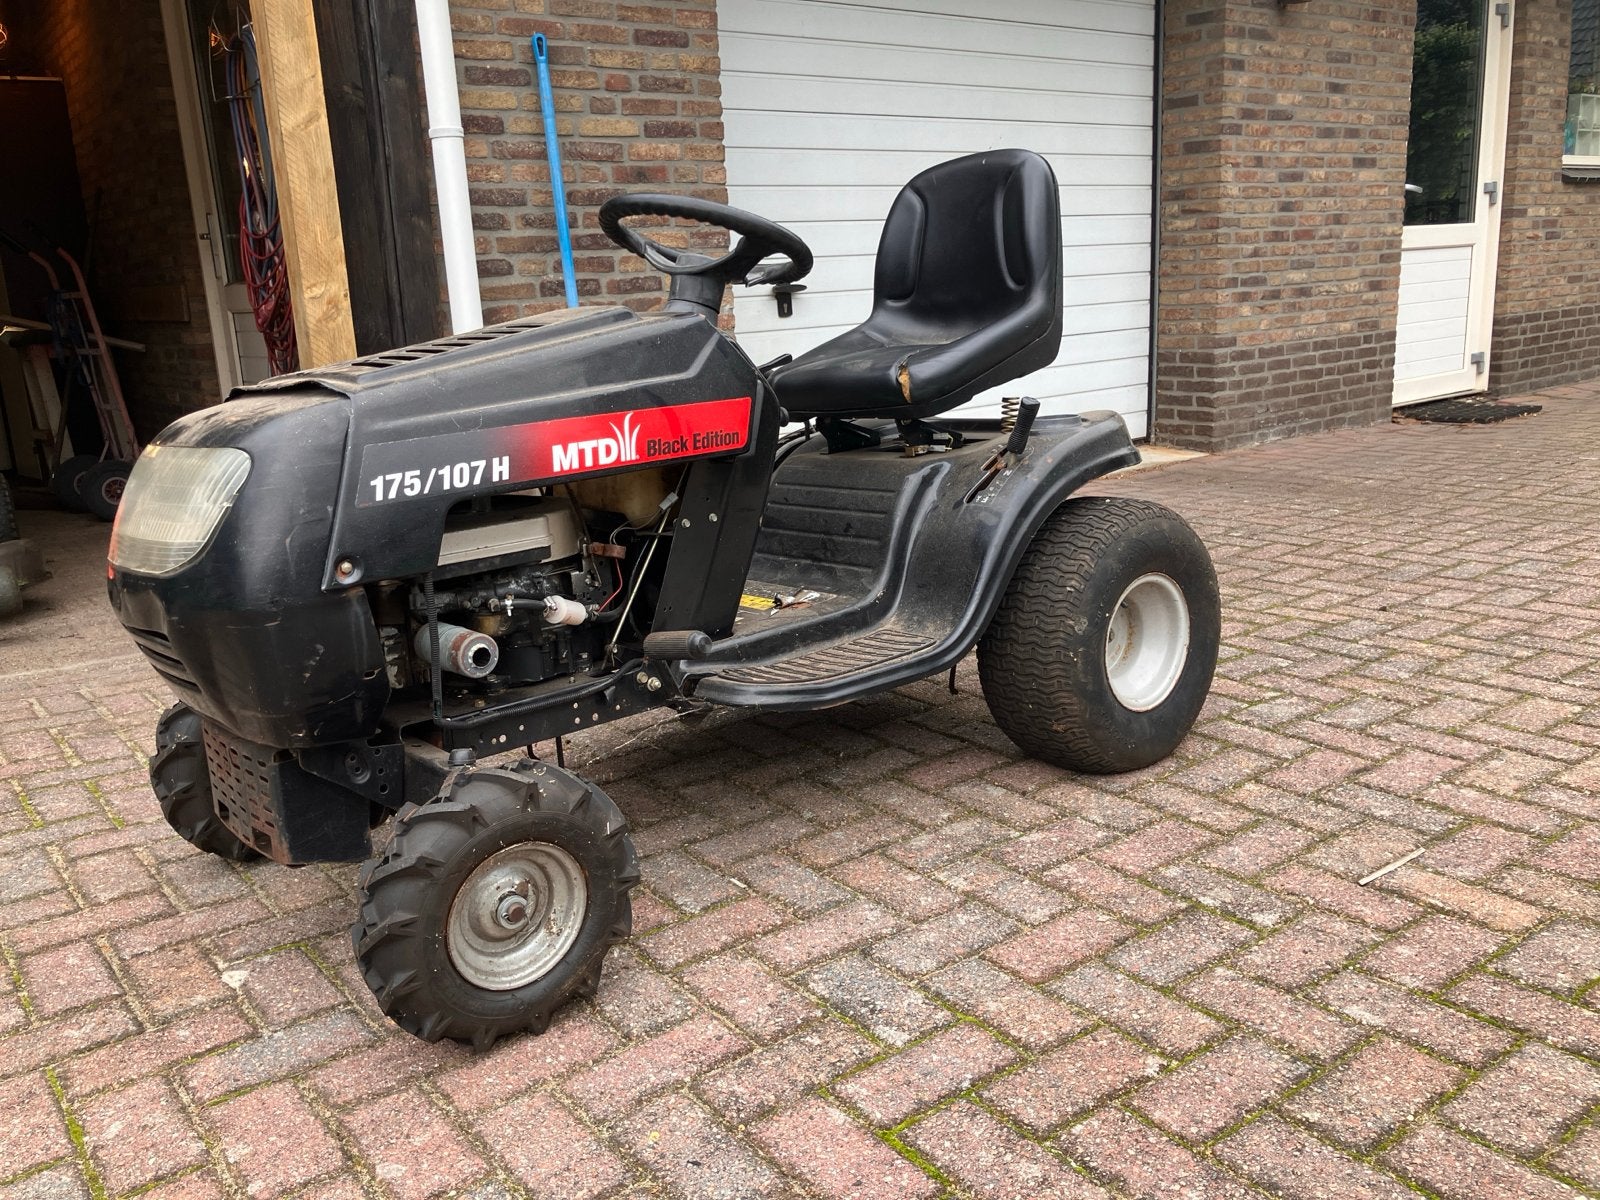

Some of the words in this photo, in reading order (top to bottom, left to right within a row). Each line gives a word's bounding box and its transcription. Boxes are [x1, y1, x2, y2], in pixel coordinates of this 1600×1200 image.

[552, 438, 618, 472] MTD
[646, 436, 689, 457] Black
[693, 431, 740, 450] Edition
[370, 459, 487, 501] 175/107
[492, 455, 509, 482] H
